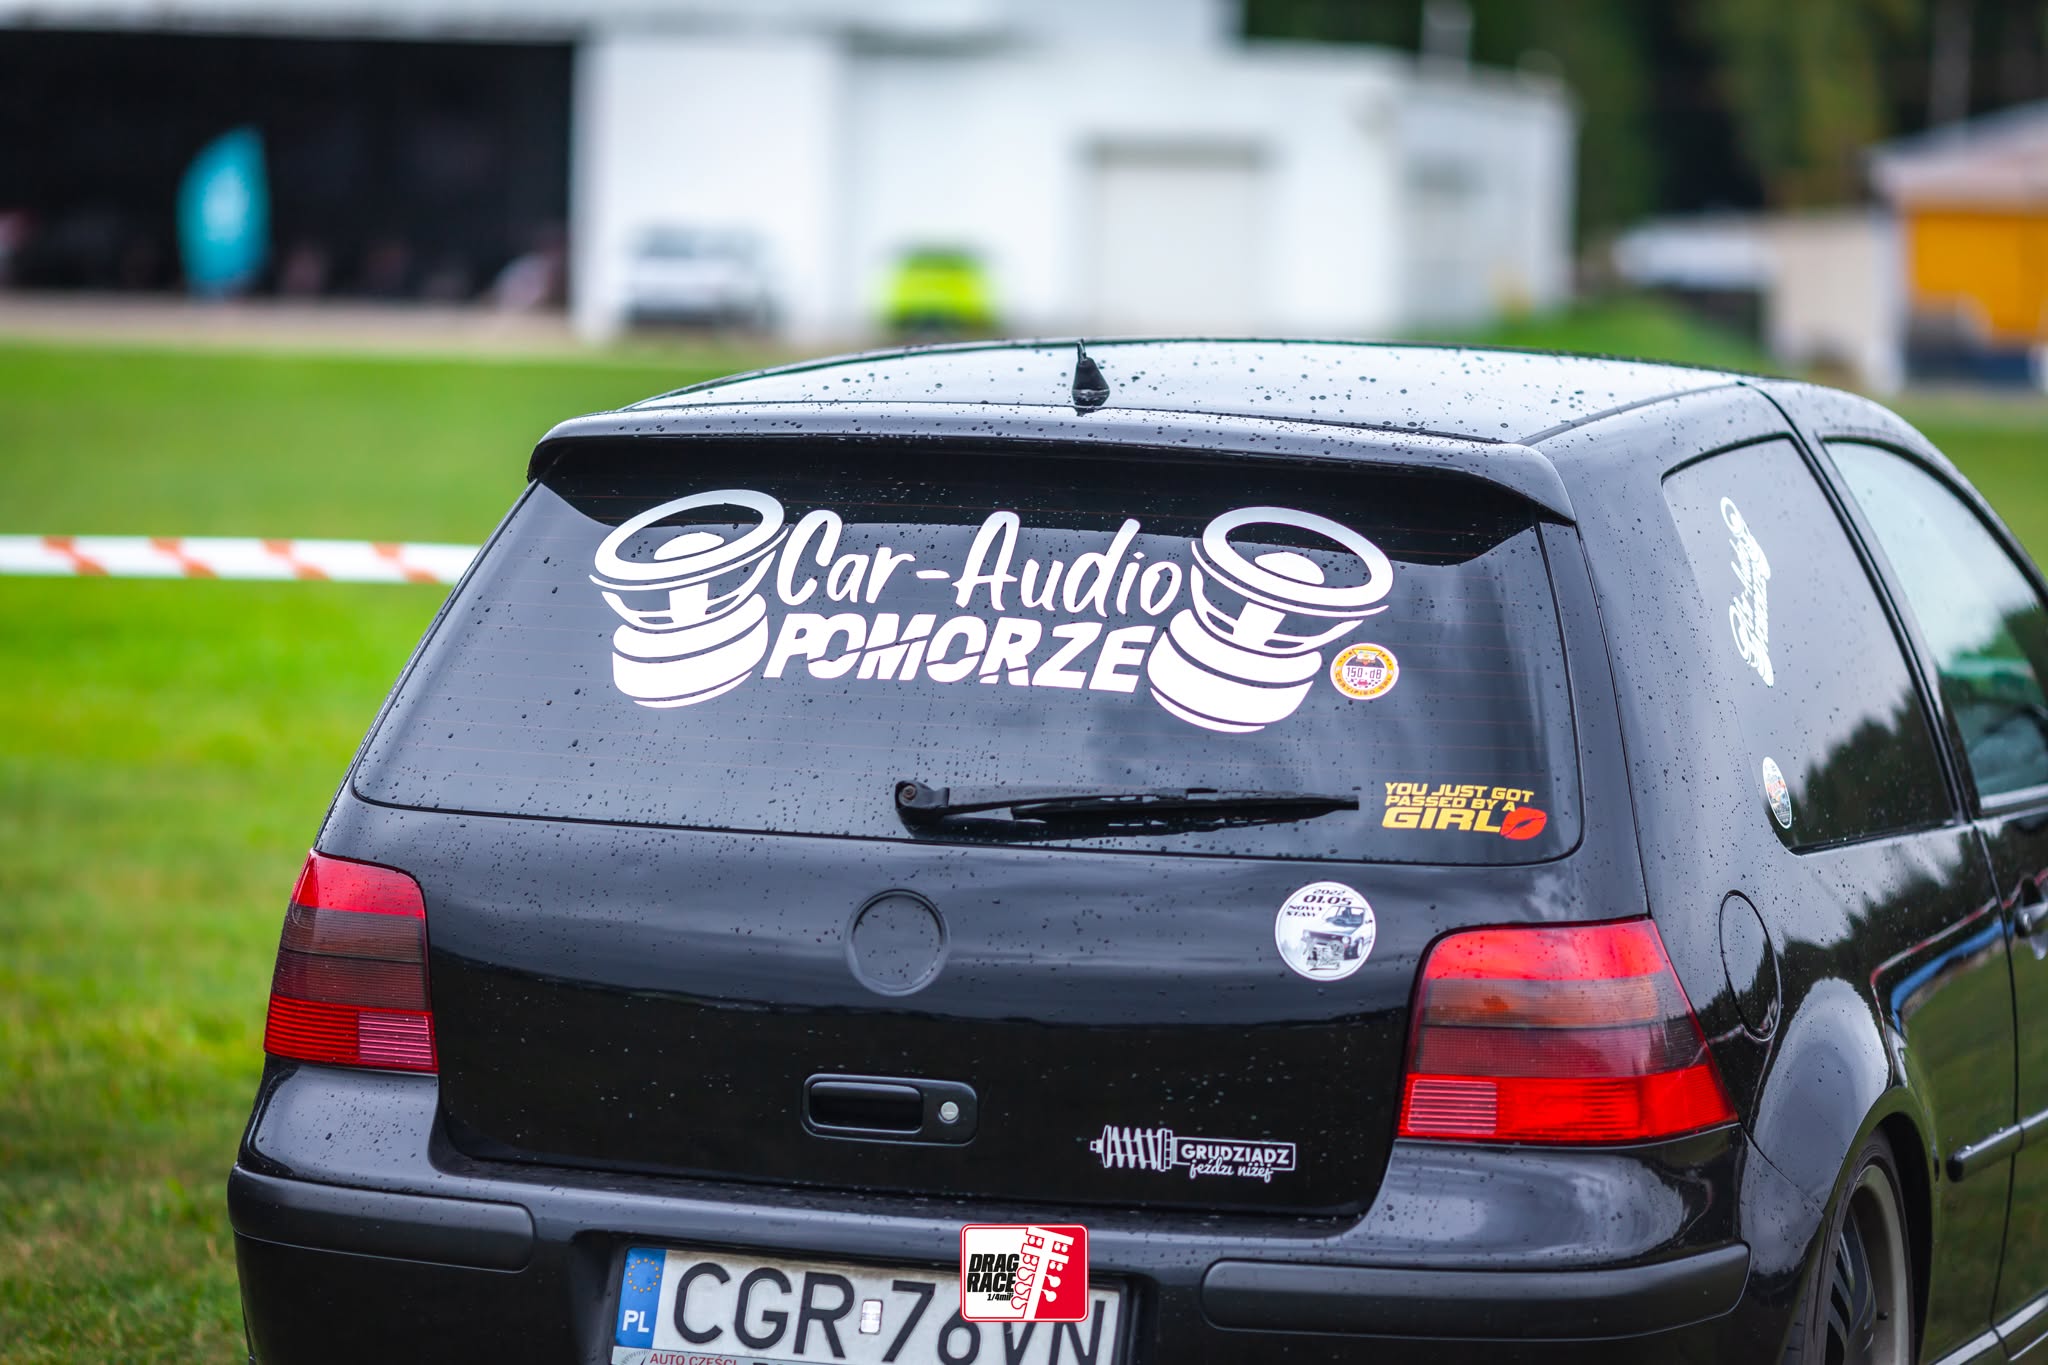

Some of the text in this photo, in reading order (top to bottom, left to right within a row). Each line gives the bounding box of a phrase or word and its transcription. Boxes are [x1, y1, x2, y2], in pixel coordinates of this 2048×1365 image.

[776, 509, 1183, 618] Car-Audio
[762, 612, 1156, 693] POMORZE
[1346, 667, 1364, 678] 150
[1385, 782, 1535, 803] YOU JUST GOT
[1385, 795, 1516, 812] PASSED BY A
[1382, 807, 1501, 832] GIRL
[622, 1309, 650, 1333] PL
[673, 1261, 856, 1359] CGR
[650, 1353, 685, 1365] AUTO
